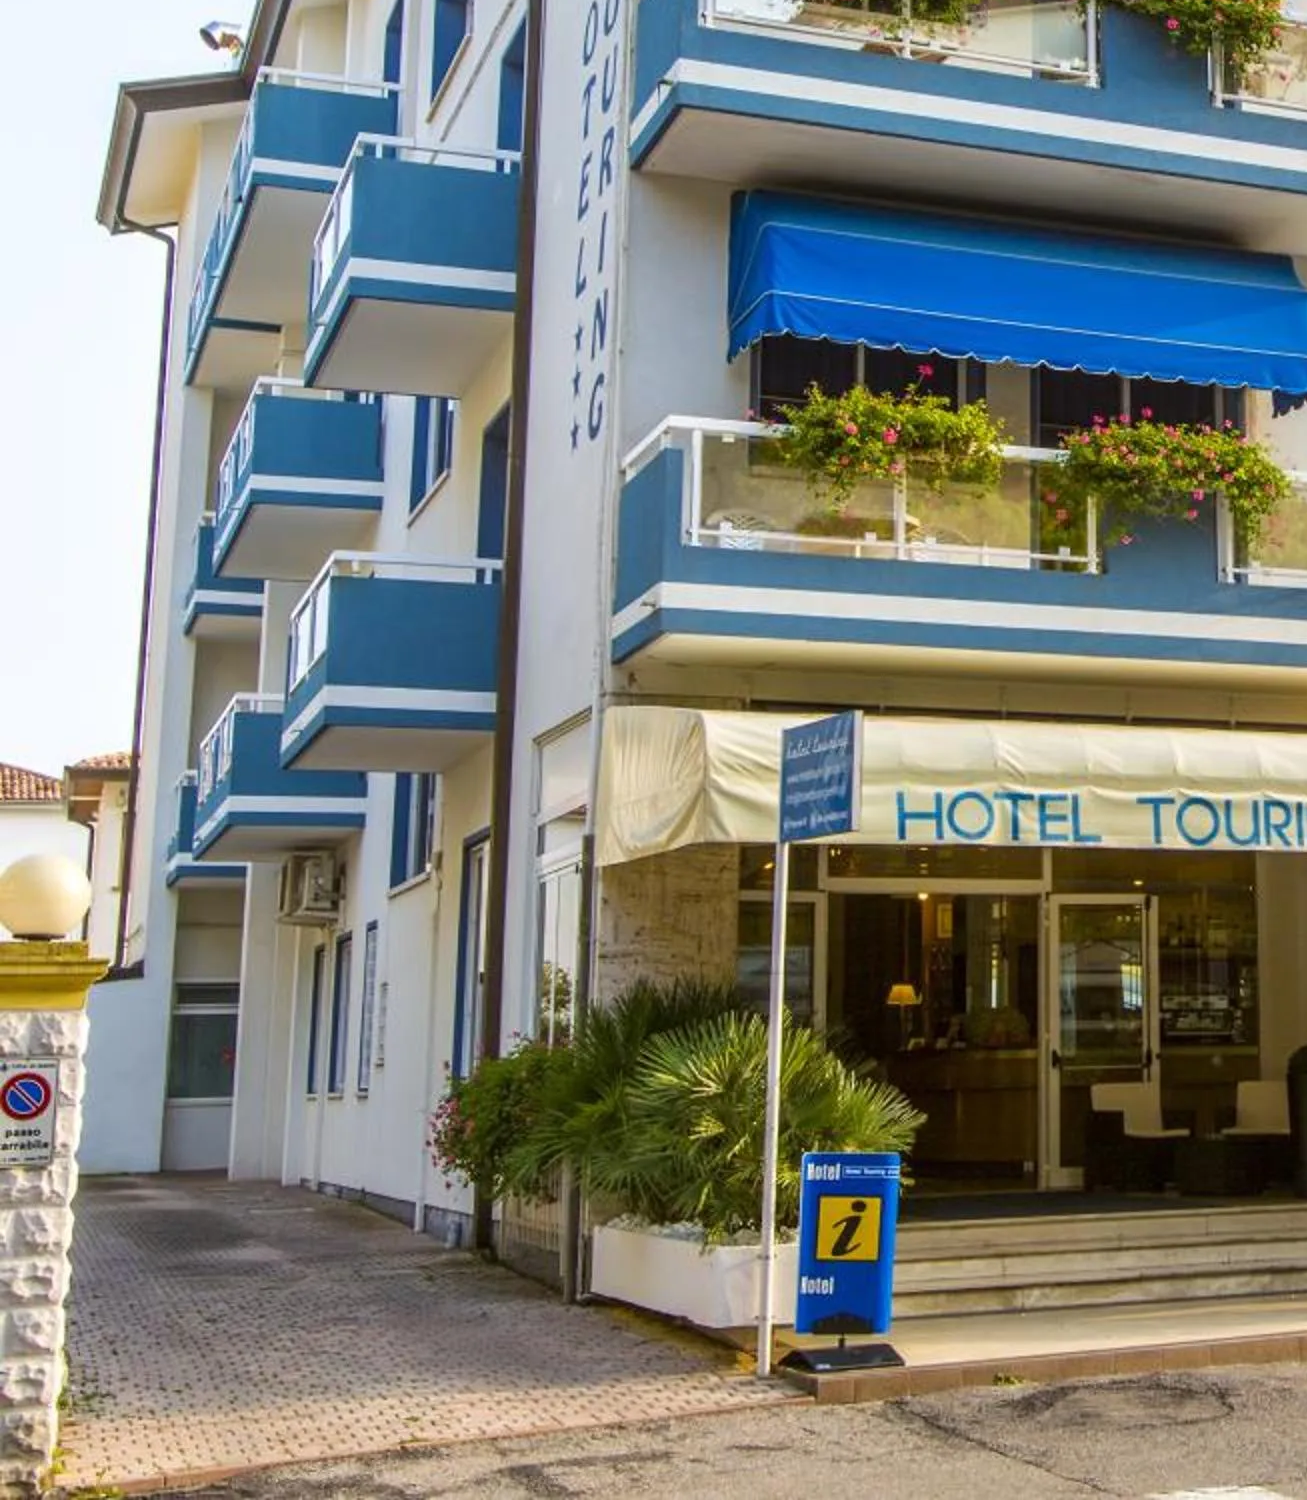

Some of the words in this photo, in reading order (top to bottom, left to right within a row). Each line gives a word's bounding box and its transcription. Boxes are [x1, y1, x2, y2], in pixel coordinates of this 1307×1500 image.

[896, 790, 1102, 843] HOTEL
[5, 1128, 42, 1138] passo
[0, 1140, 49, 1151] arrabile
[806, 1163, 841, 1181] Hotel
[800, 1276, 835, 1295] Hotel
